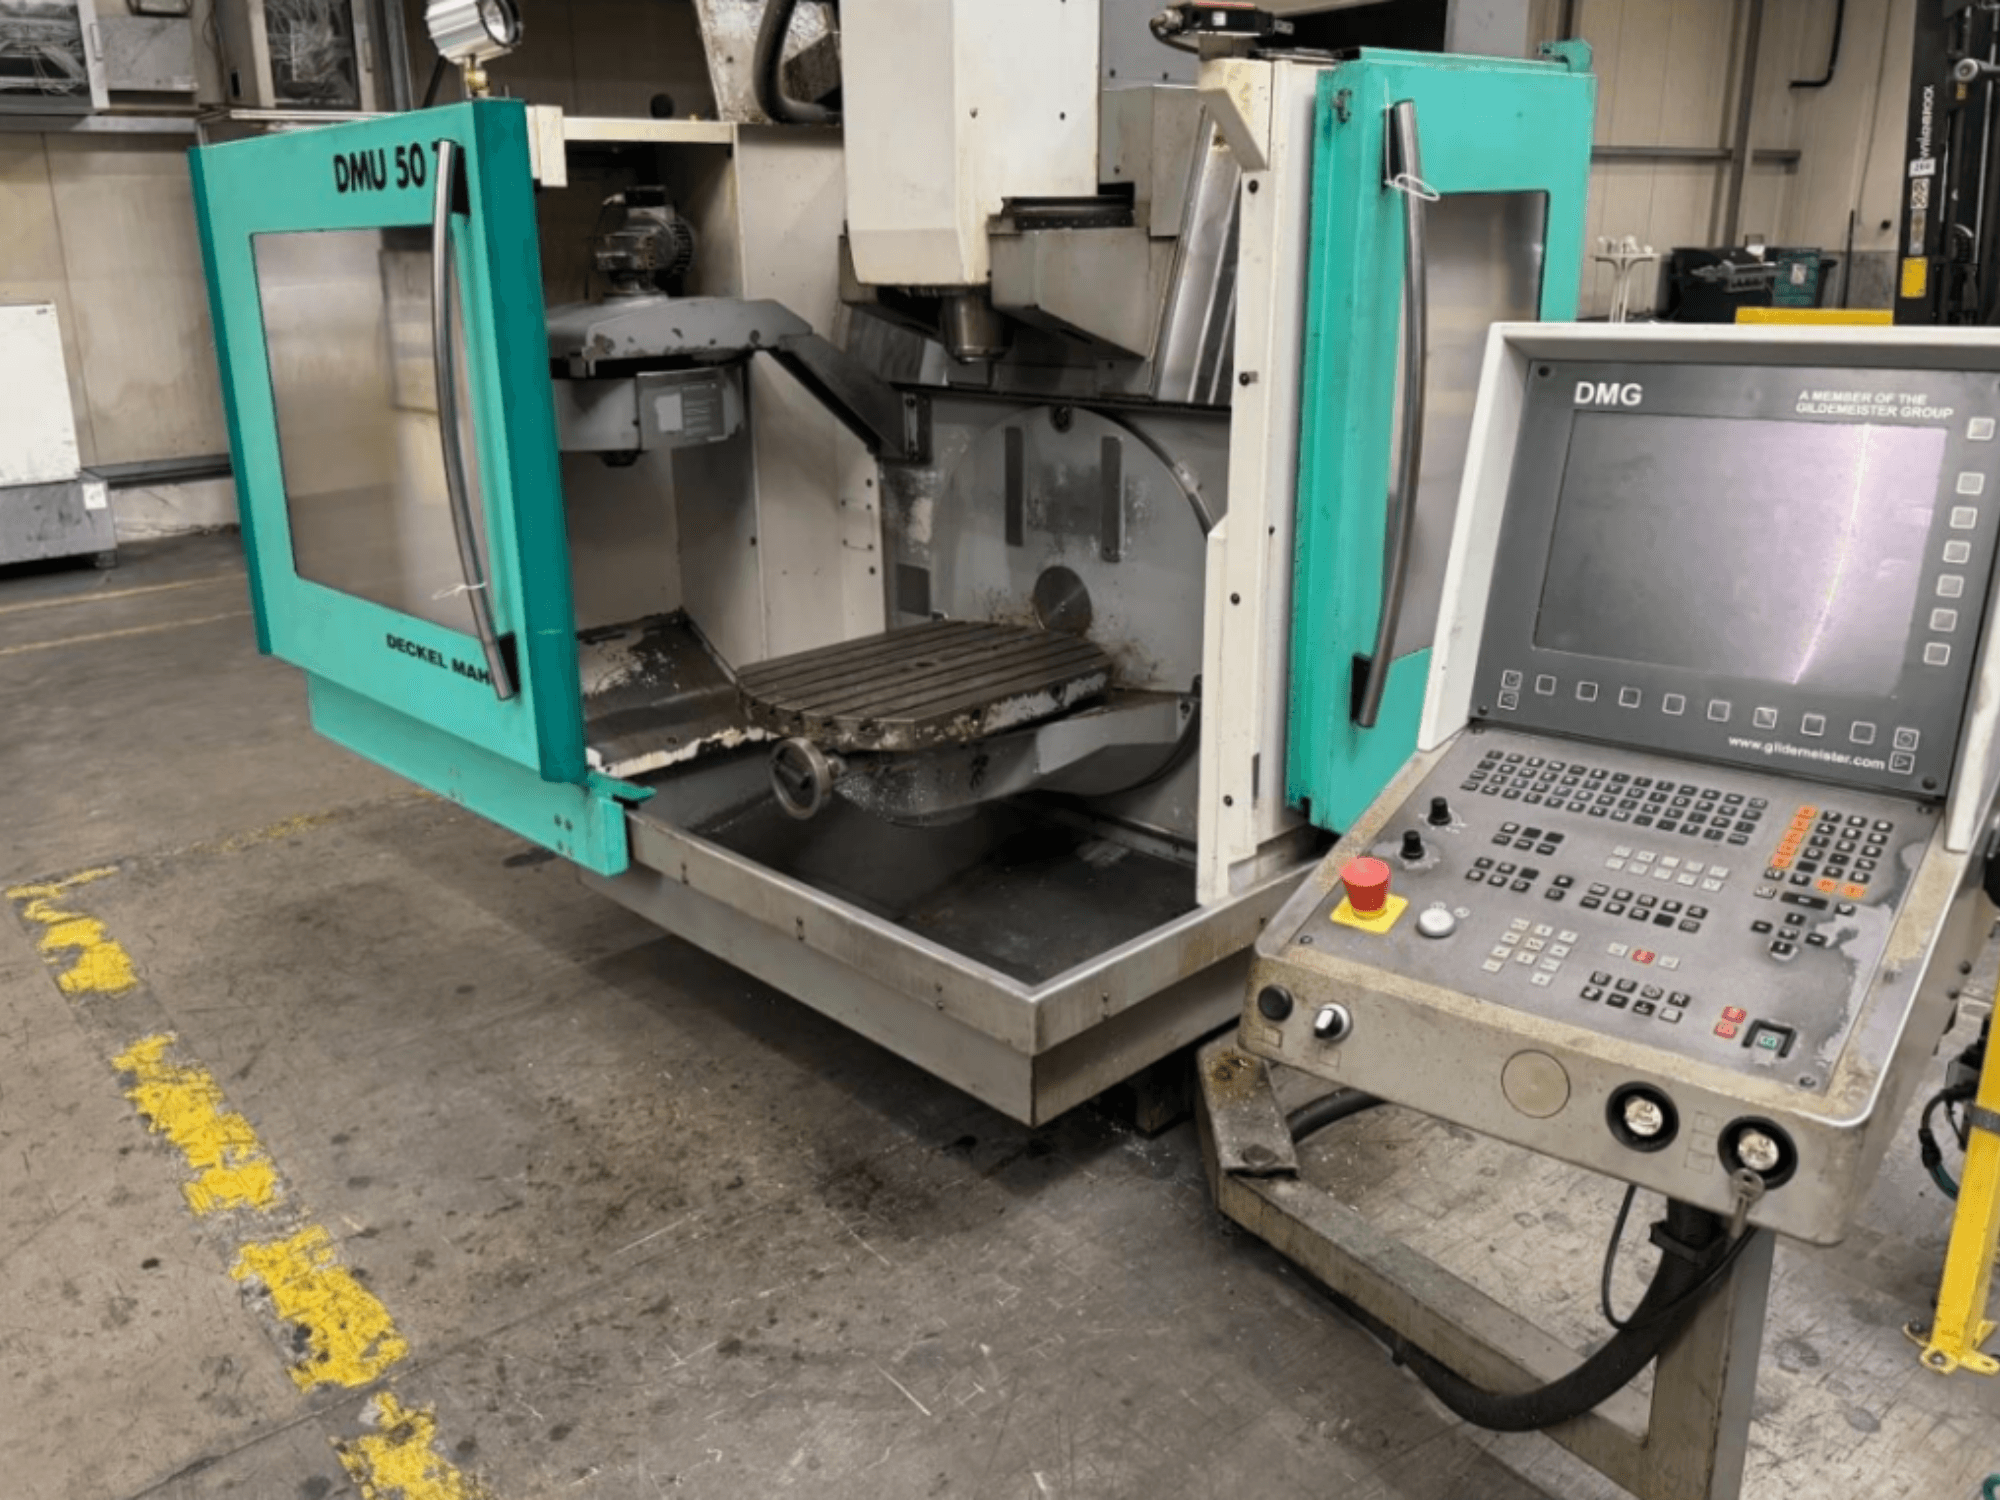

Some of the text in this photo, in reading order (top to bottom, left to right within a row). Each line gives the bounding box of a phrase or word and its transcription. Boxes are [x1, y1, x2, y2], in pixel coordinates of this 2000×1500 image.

[333, 142, 426, 193] DMU 50
[1574, 381, 1643, 405] DMG
[1799, 389, 1928, 406] A MEMBER OF THE
[1796, 402, 1954, 419] GILDEMEISTER GROUP
[386, 633, 491, 686] DECKEL MAH
